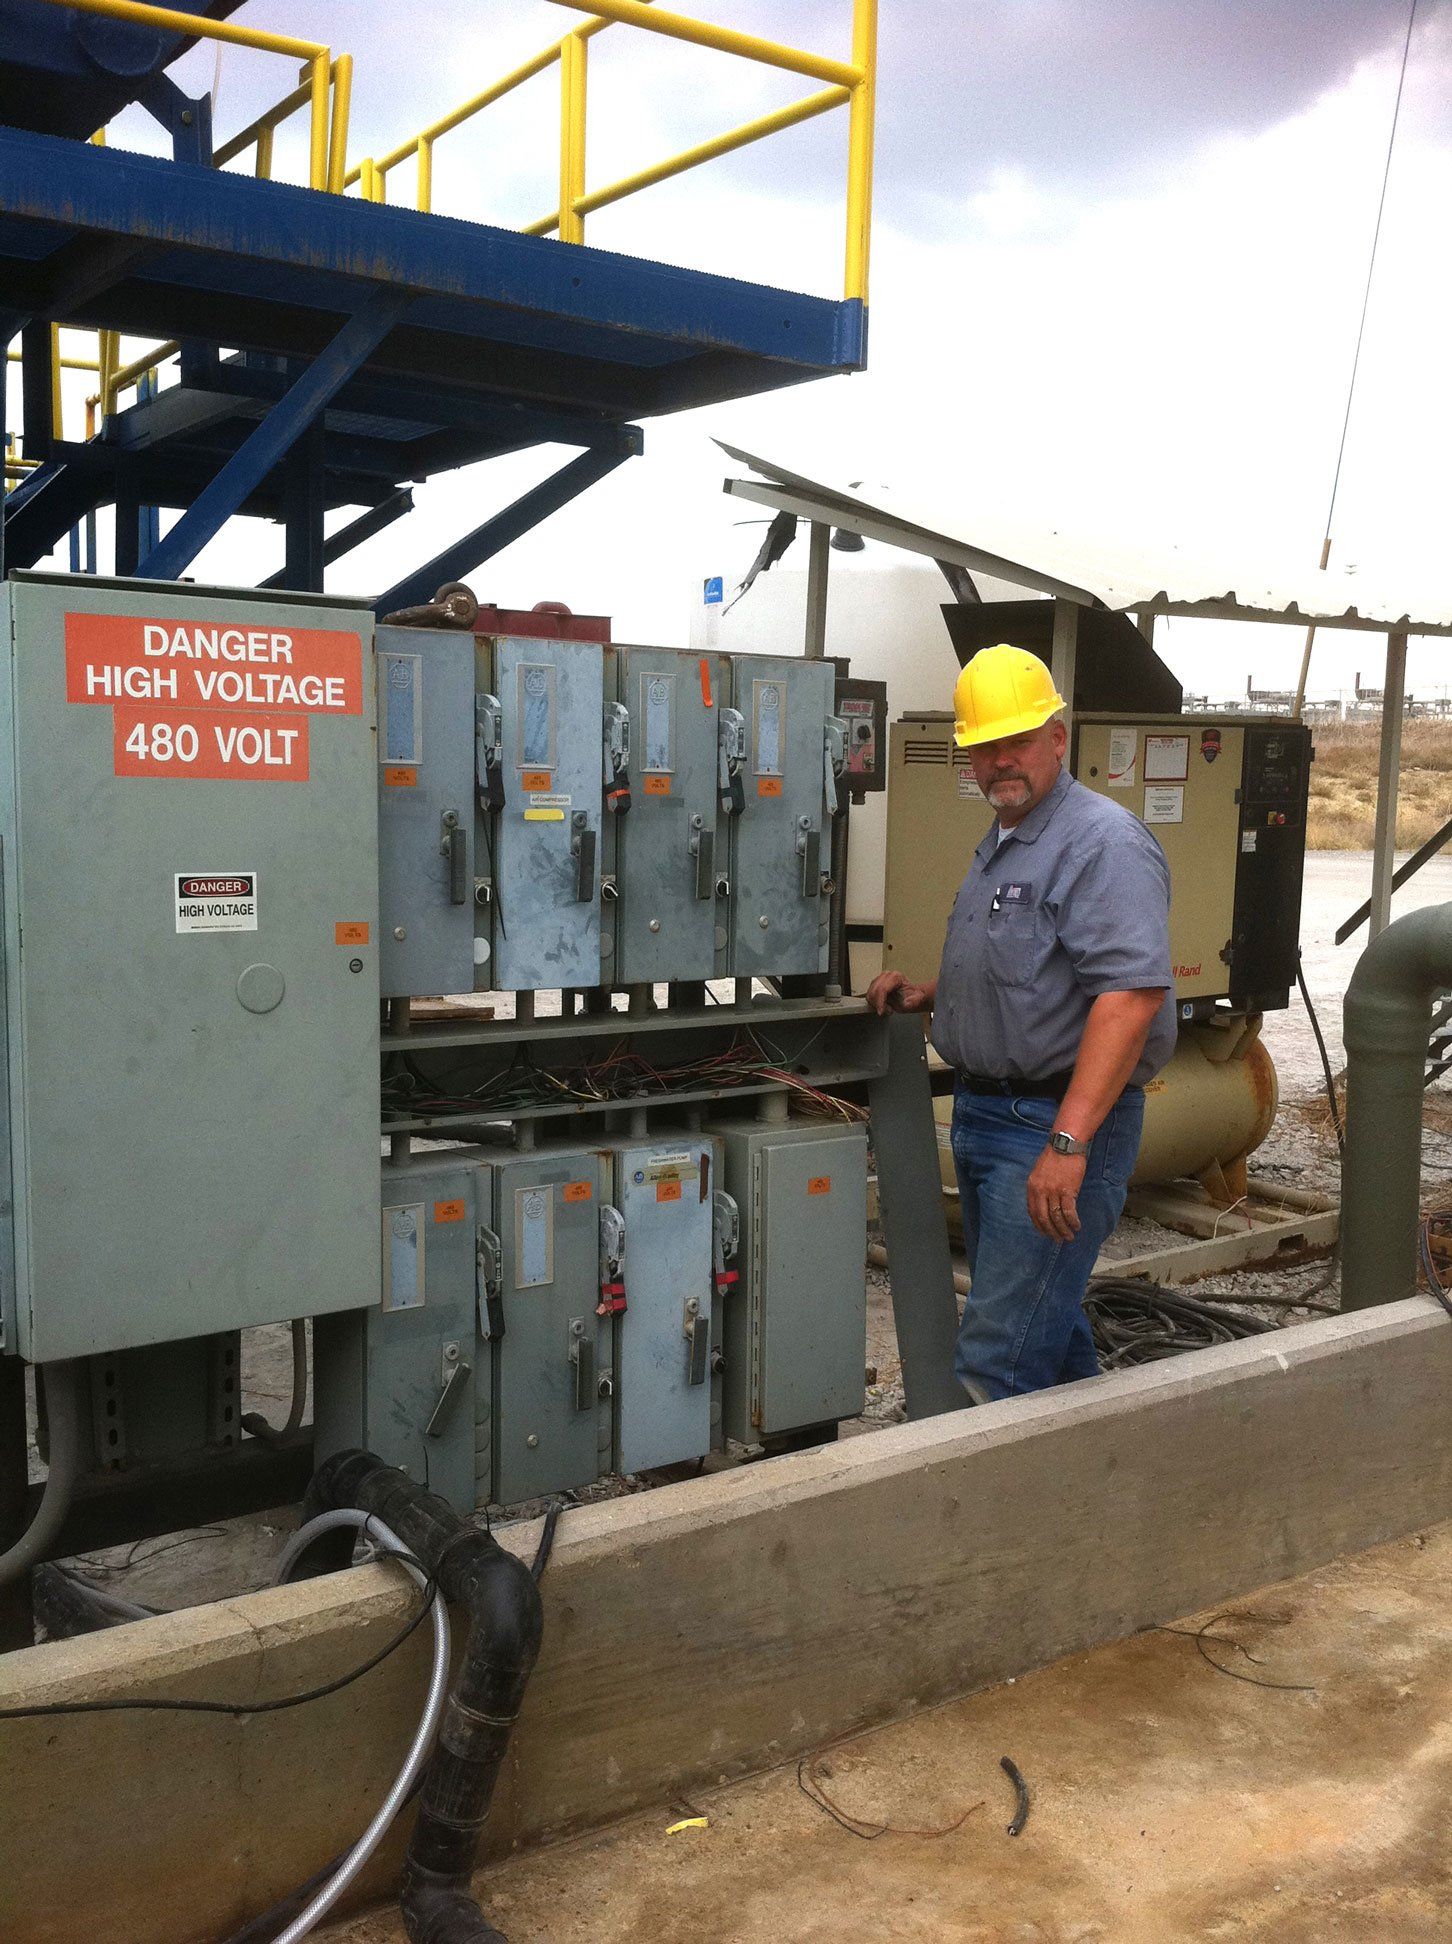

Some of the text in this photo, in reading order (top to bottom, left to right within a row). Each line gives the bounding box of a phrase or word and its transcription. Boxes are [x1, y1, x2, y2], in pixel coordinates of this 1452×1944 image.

[143, 625, 293, 664] DANGER
[86, 664, 346, 707] HIGH VOLTAGE
[125, 722, 299, 765] 480 VOLT
[190, 881, 242, 893] DANGER
[179, 903, 254, 918] HIGH VOLTAGE
[1179, 963, 1202, 978] Rand
